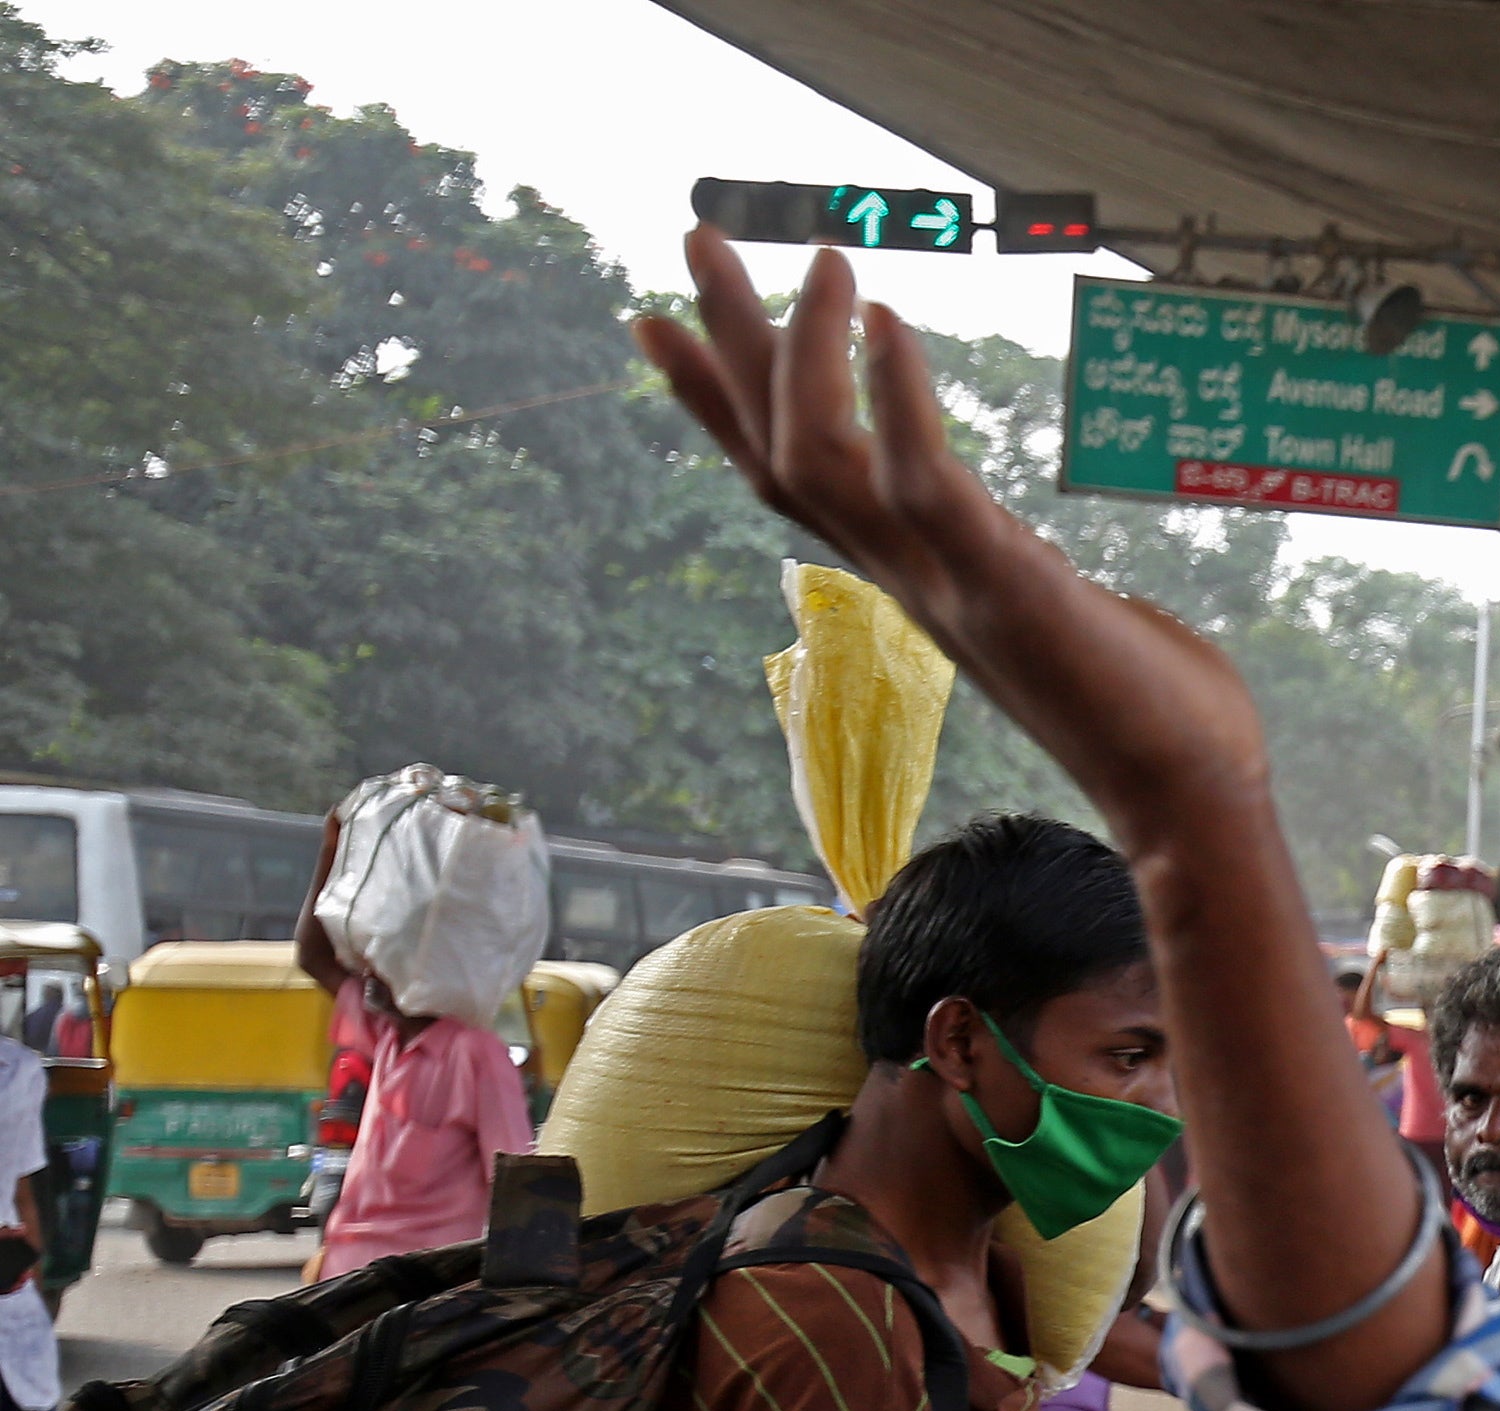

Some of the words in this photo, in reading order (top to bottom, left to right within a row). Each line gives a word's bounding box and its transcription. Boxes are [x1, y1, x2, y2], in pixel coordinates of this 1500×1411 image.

[1394, 323, 1446, 359] oad
[1266, 367, 1369, 412] Avenue
[1372, 377, 1445, 419] Road
[1263, 425, 1336, 466] Town
[1339, 432, 1395, 471] Hall
[1290, 475, 1394, 508] B-TRAC
